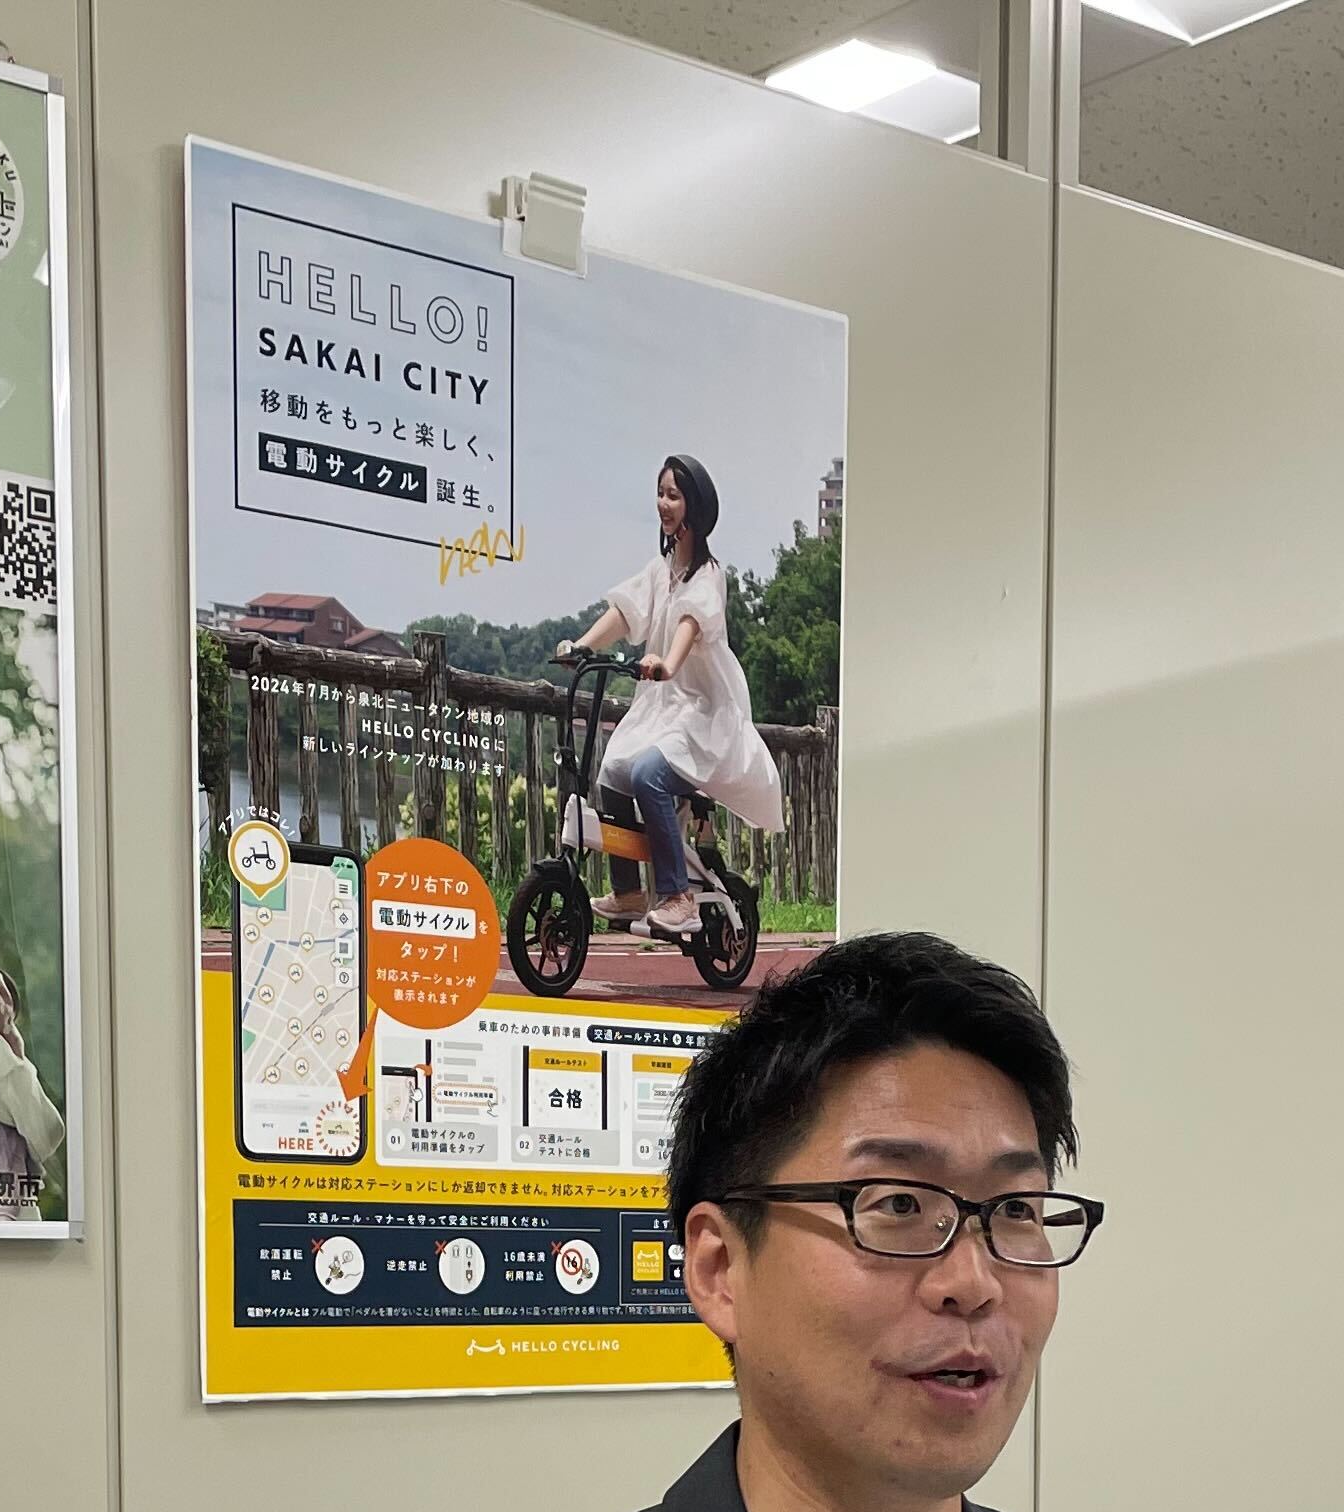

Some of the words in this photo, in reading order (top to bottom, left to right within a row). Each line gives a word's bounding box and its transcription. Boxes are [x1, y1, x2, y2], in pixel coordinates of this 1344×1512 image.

[258, 250, 488, 353] HELLO!
[258, 326, 383, 383] SAKAI
[402, 361, 490, 406] CITY
[260, 388, 494, 462] 移動をもっと楽しく、
[264, 440, 420, 494] 電動サイクル
[250, 674, 506, 728] 2024年7月から泉北ニュータウン地域の
[361, 717, 415, 740] HELLO
[302, 734, 506, 778] 新しいラインナップが加わります
[376, 871, 469, 896] アプリ右下の
[378, 906, 470, 932] 電動サイクル
[375, 967, 477, 988] 対応ステーションが
[393, 989, 460, 1006] 表示されます
[478, 1020, 582, 1040] 乗車のための事前準備
[548, 1087, 583, 1110] 合格
[277, 1136, 314, 1151] HERE
[390, 1135, 402, 1145] 01
[410, 1128, 476, 1142] 電動サイクルの
[538, 1133, 582, 1145] 交通ルール
[410, 1141, 486, 1155] 利用準備をタップ
[519, 1140, 530, 1150] 02
[538, 1147, 591, 1159] テストに合格
[639, 1144, 650, 1154] 03
[259, 1248, 304, 1261] 飲酒運転
[386, 1259, 428, 1272] 逆走禁止
[271, 1269, 292, 1281] 禁止
[511, 1338, 557, 1353] HELLO
[562, 1338, 621, 1352] CYCLING
